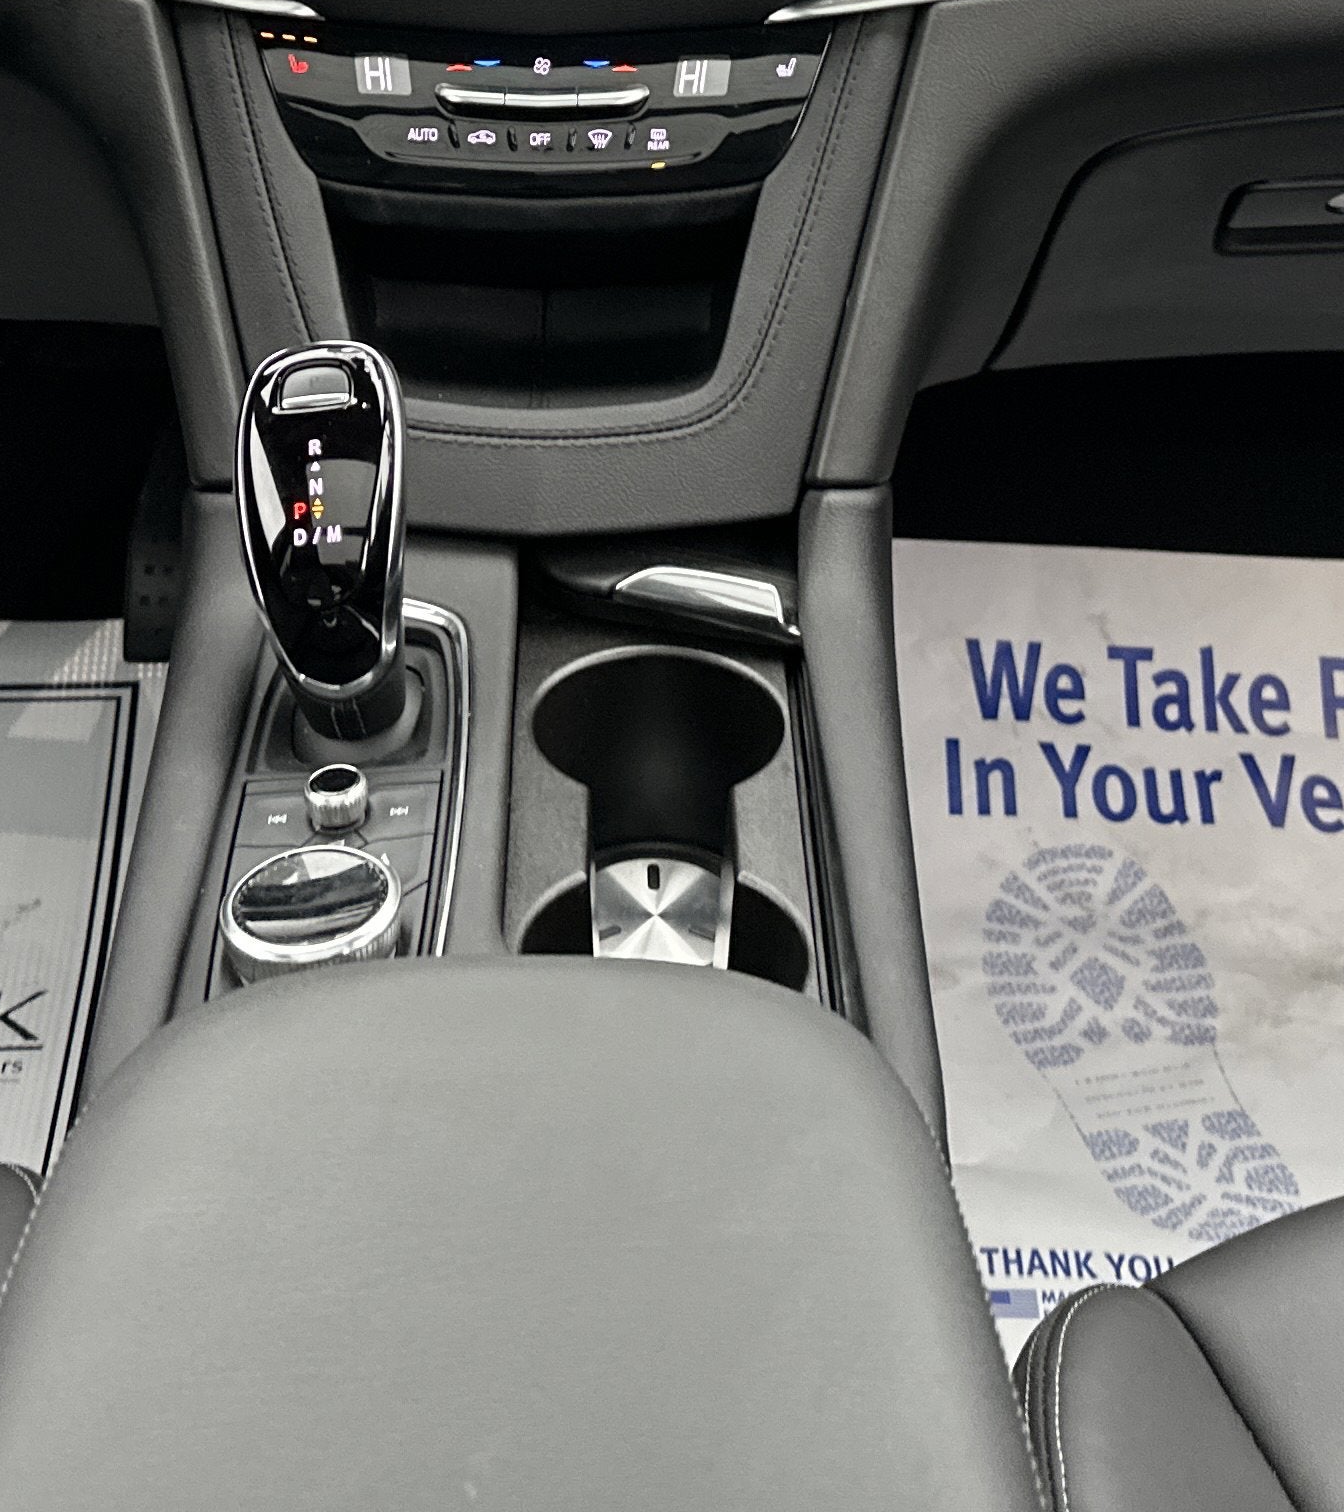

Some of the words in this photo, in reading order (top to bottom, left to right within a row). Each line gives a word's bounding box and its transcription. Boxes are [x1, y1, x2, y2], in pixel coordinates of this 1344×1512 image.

[364, 56, 393, 91] HI
[679, 59, 708, 94] HI
[407, 127, 438, 141] AUTO
[529, 133, 551, 146] OFF
[308, 438, 322, 456] R
[309, 477, 323, 495] N
[293, 502, 307, 519] P
[965, 637, 1086, 725] We
[1107, 644, 1292, 737] Take
[945, 737, 1017, 818] In
[1038, 740, 1222, 827] Your
[979, 1246, 1097, 1280] THANK
